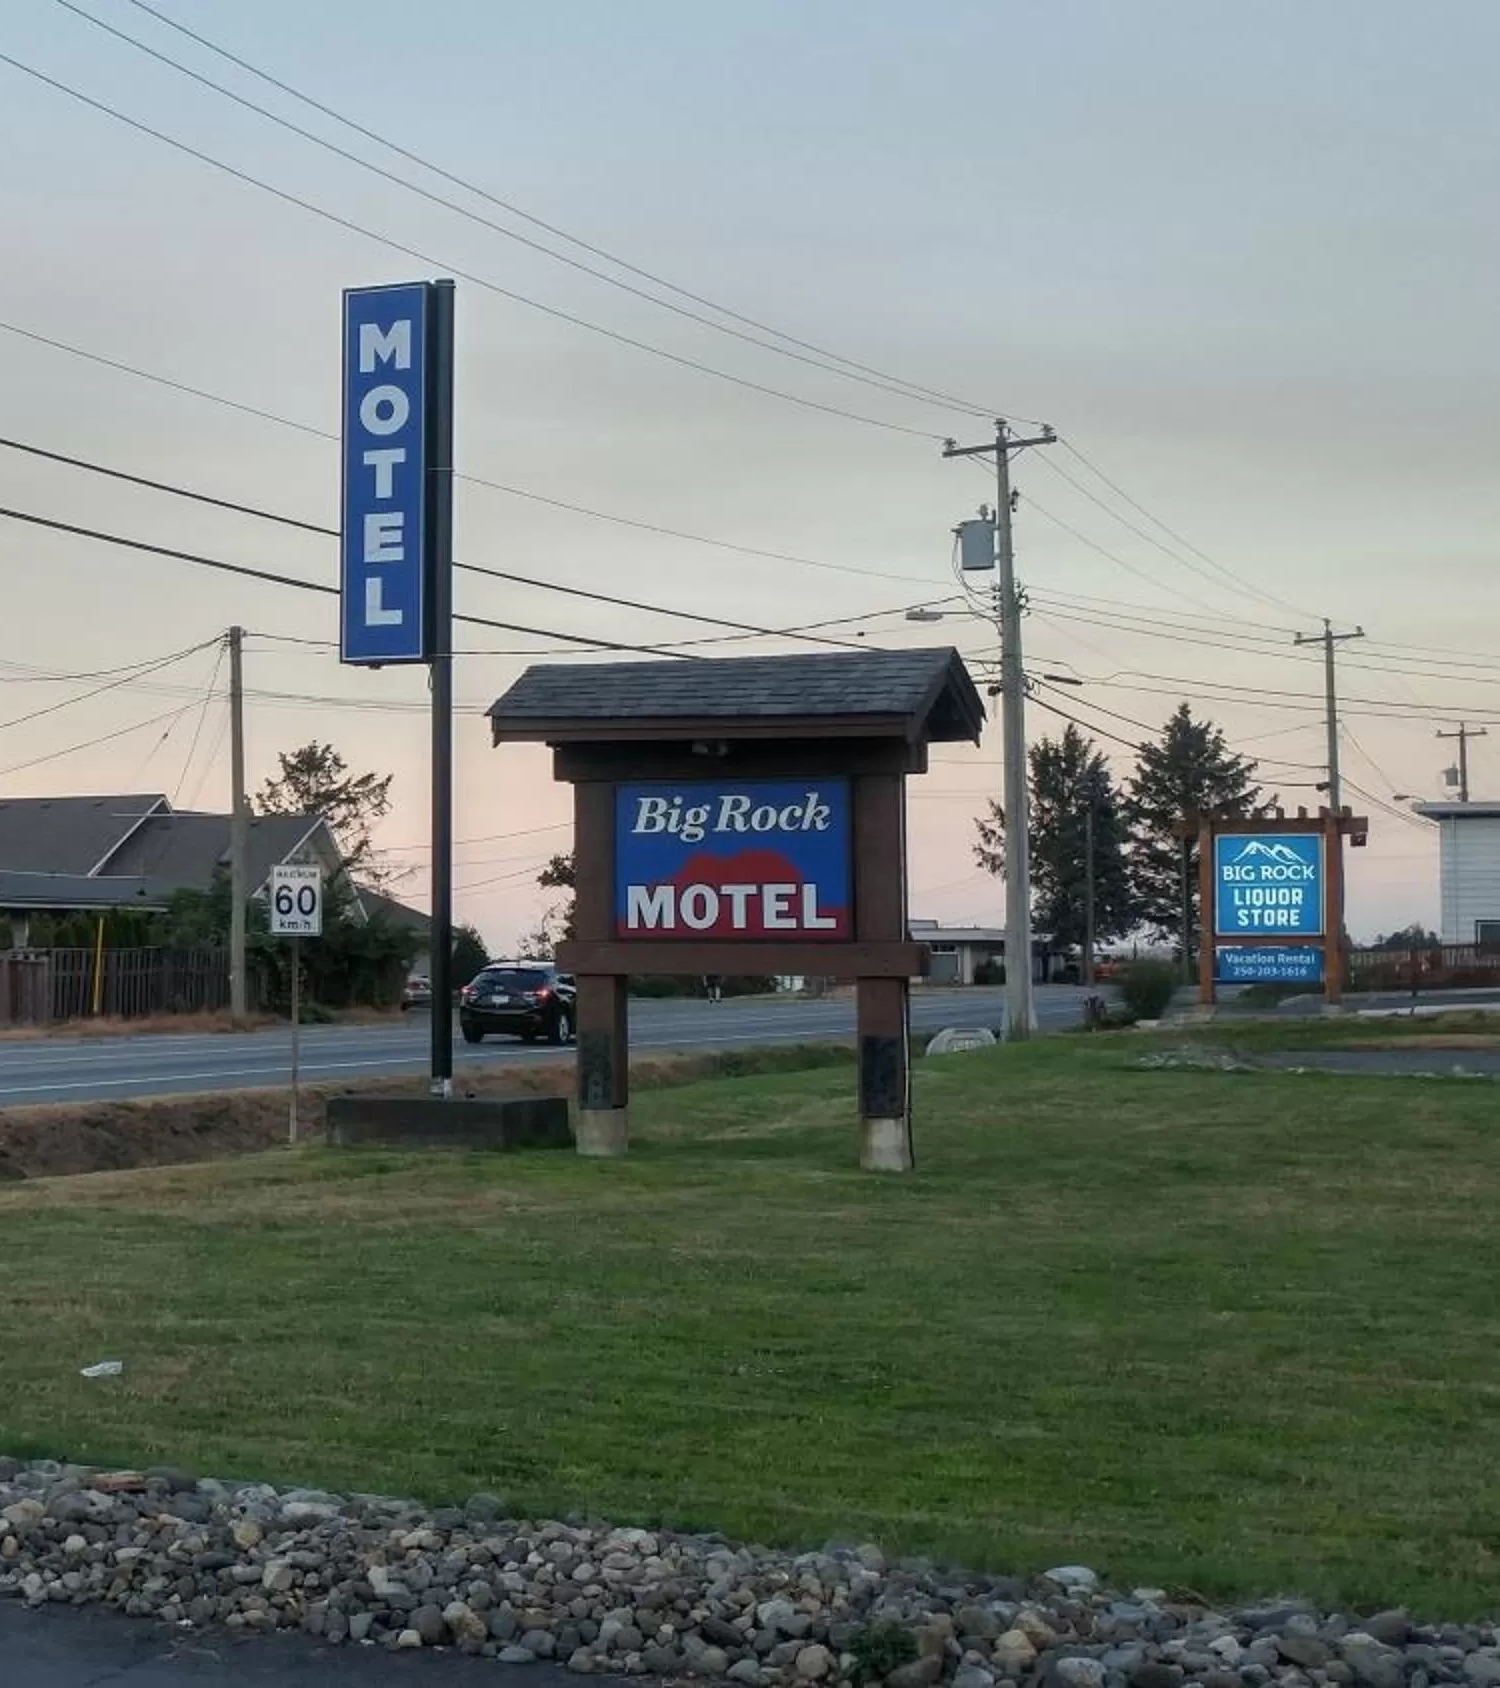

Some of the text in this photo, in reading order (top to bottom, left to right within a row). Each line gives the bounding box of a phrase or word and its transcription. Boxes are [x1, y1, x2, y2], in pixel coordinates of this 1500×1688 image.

[359, 319, 412, 627] MOTEL
[632, 792, 832, 843] Big Rock
[1222, 864, 1316, 881] BIG ROCK
[276, 884, 317, 916] 60
[627, 883, 837, 930] MOTEL
[1234, 888, 1303, 907] LIQUOR
[1237, 908, 1301, 927] STORE
[1225, 952, 1315, 965] Vacation Rental
